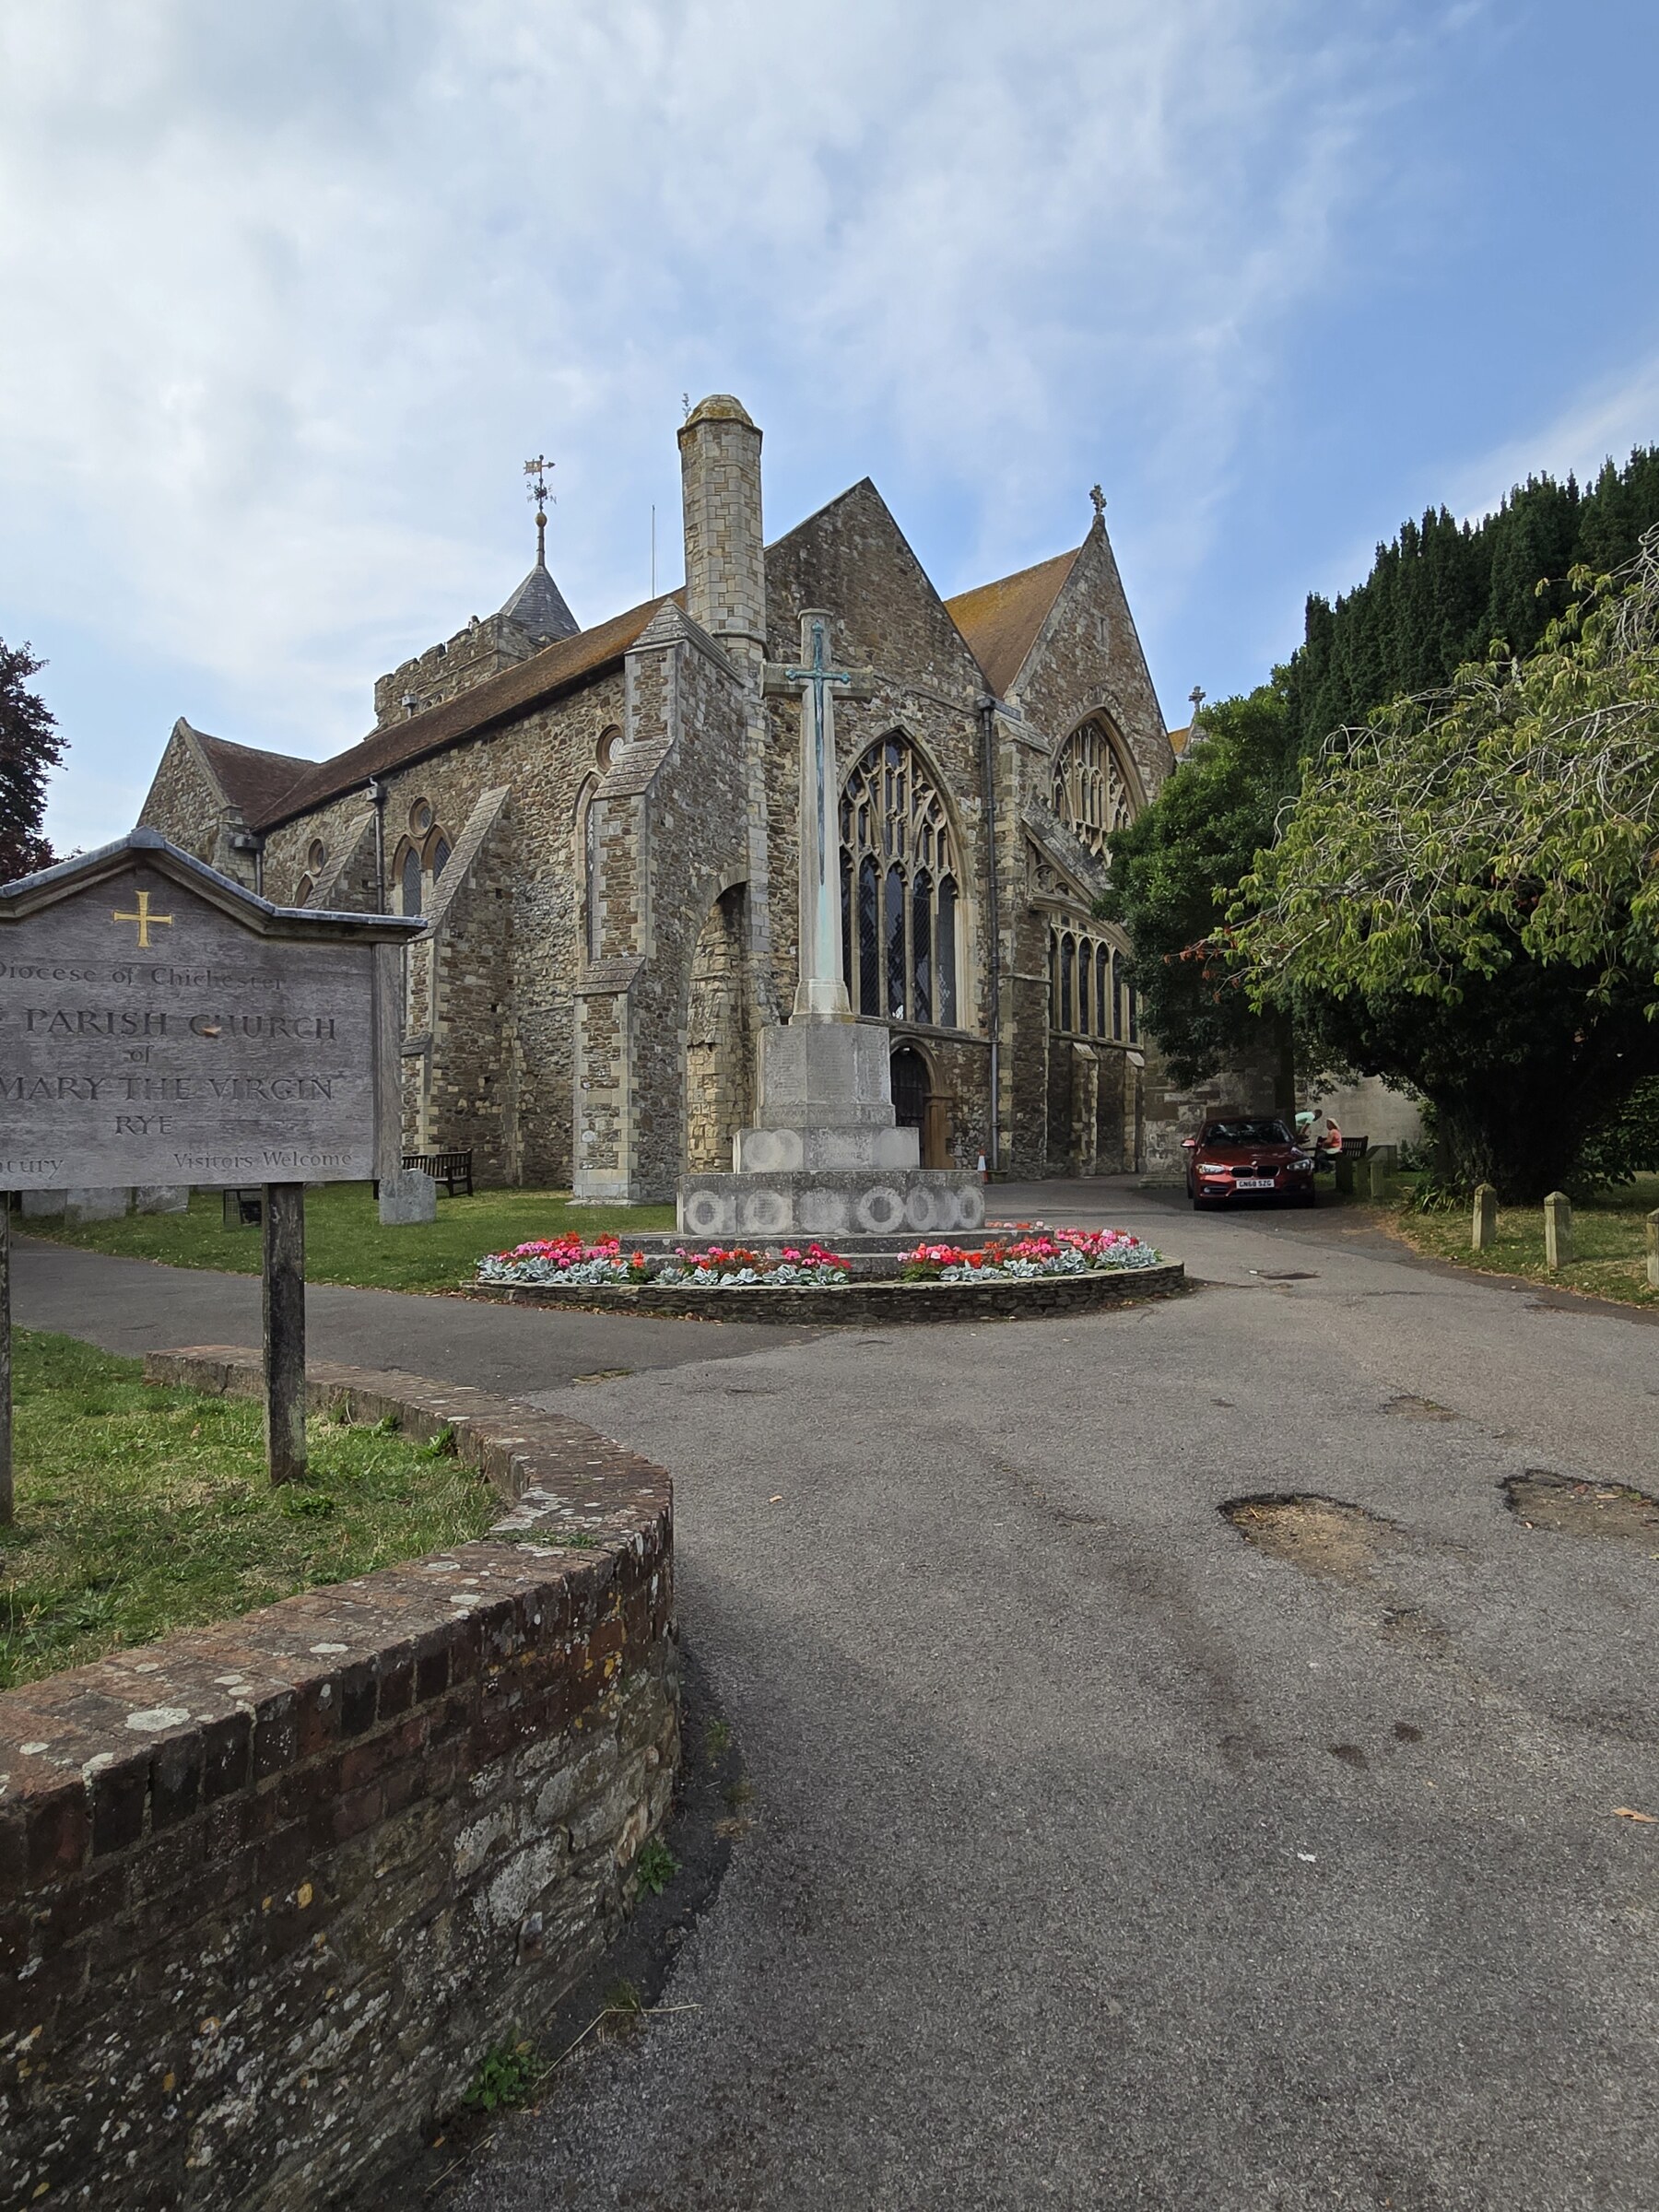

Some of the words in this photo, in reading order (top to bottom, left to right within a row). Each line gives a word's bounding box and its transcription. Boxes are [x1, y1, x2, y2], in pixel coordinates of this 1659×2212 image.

[112, 966, 136, 985] of
[151, 967, 286, 991] Chichester
[26, 1008, 168, 1036] PARISH
[189, 1014, 336, 1041] CHURCH
[129, 1045, 154, 1064] of
[119, 1077, 192, 1100] THE
[208, 1077, 333, 1100] VIRGIN
[115, 1115, 173, 1135] RYE
[173, 1153, 253, 1169] Visitors
[263, 1151, 352, 1168] Welcome
